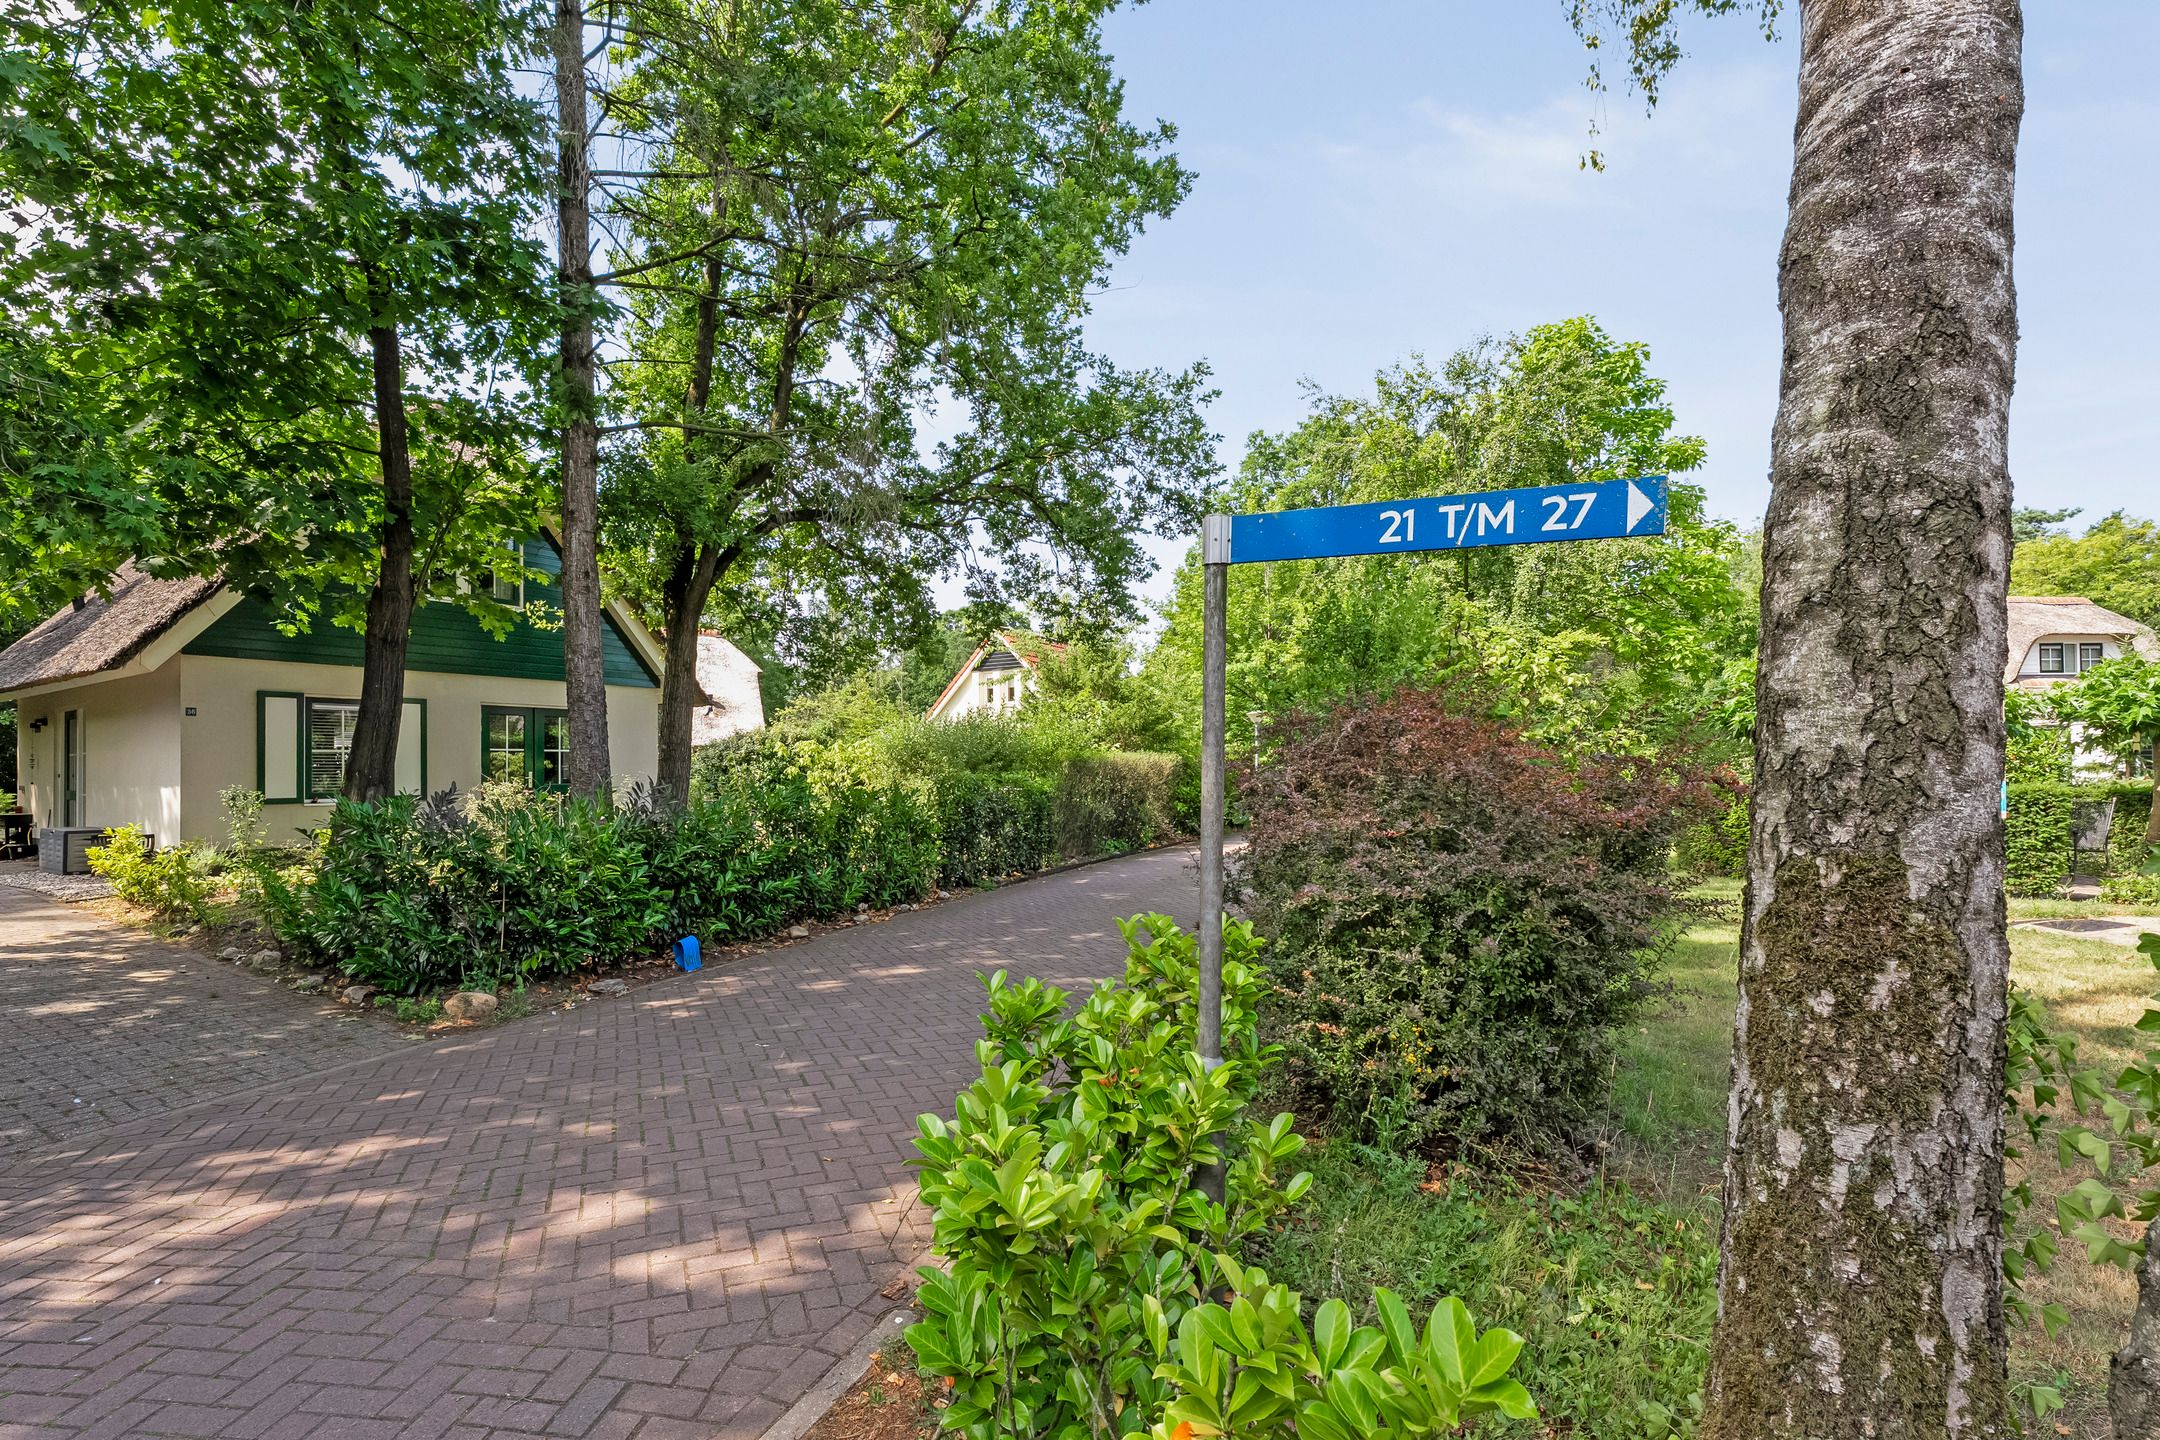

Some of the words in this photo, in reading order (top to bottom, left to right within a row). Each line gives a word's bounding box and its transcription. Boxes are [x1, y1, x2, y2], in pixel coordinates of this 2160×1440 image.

[1379, 509, 1415, 544] 21
[1438, 501, 1515, 546] T/M
[1541, 492, 1598, 532] 27
